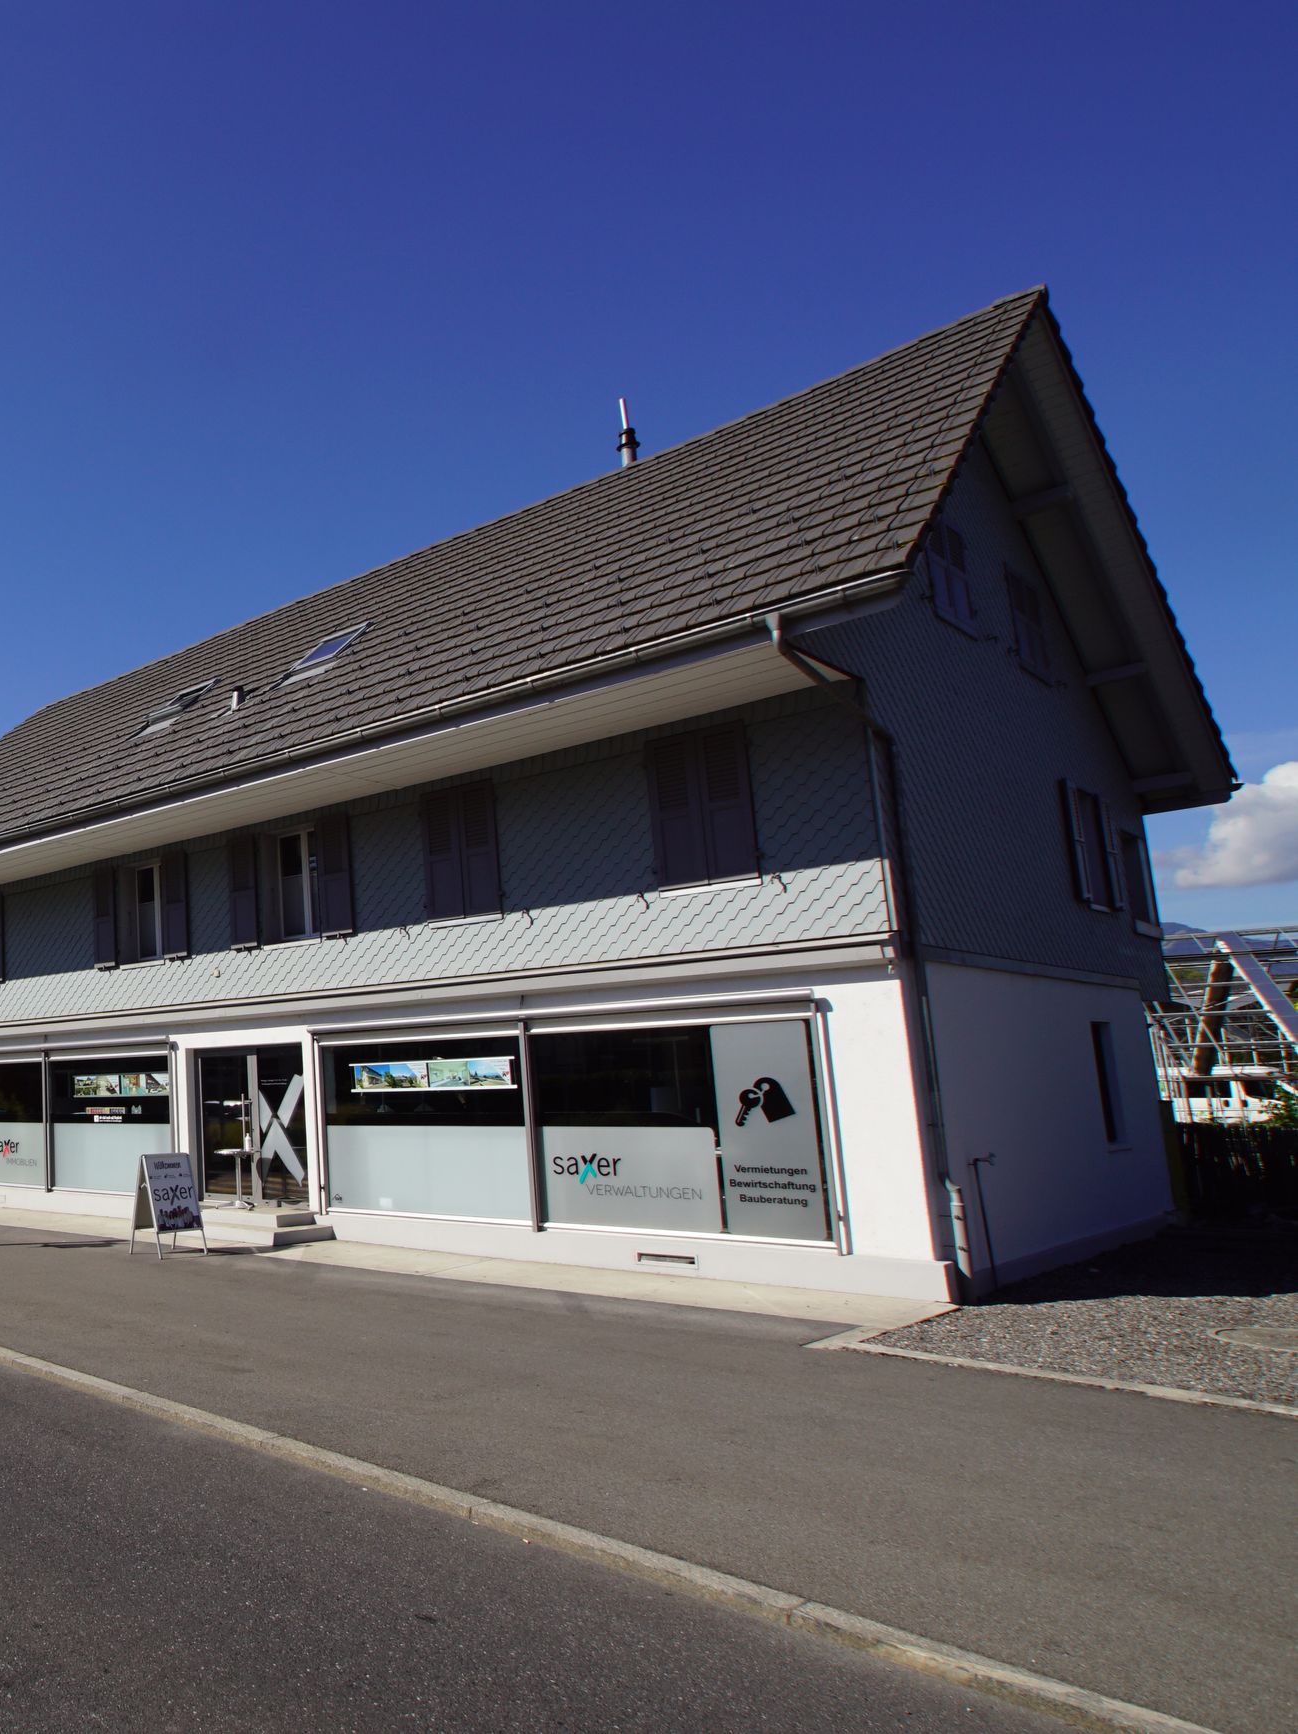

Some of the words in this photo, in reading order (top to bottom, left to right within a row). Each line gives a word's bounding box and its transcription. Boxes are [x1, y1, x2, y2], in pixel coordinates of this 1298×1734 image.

[734, 1164, 808, 1177] Vermietungen
[585, 1183, 703, 1201] VERWALTUNGEN
[729, 1178, 816, 1193] Bewirtschaftung
[739, 1193, 808, 1208] Bauberatung
